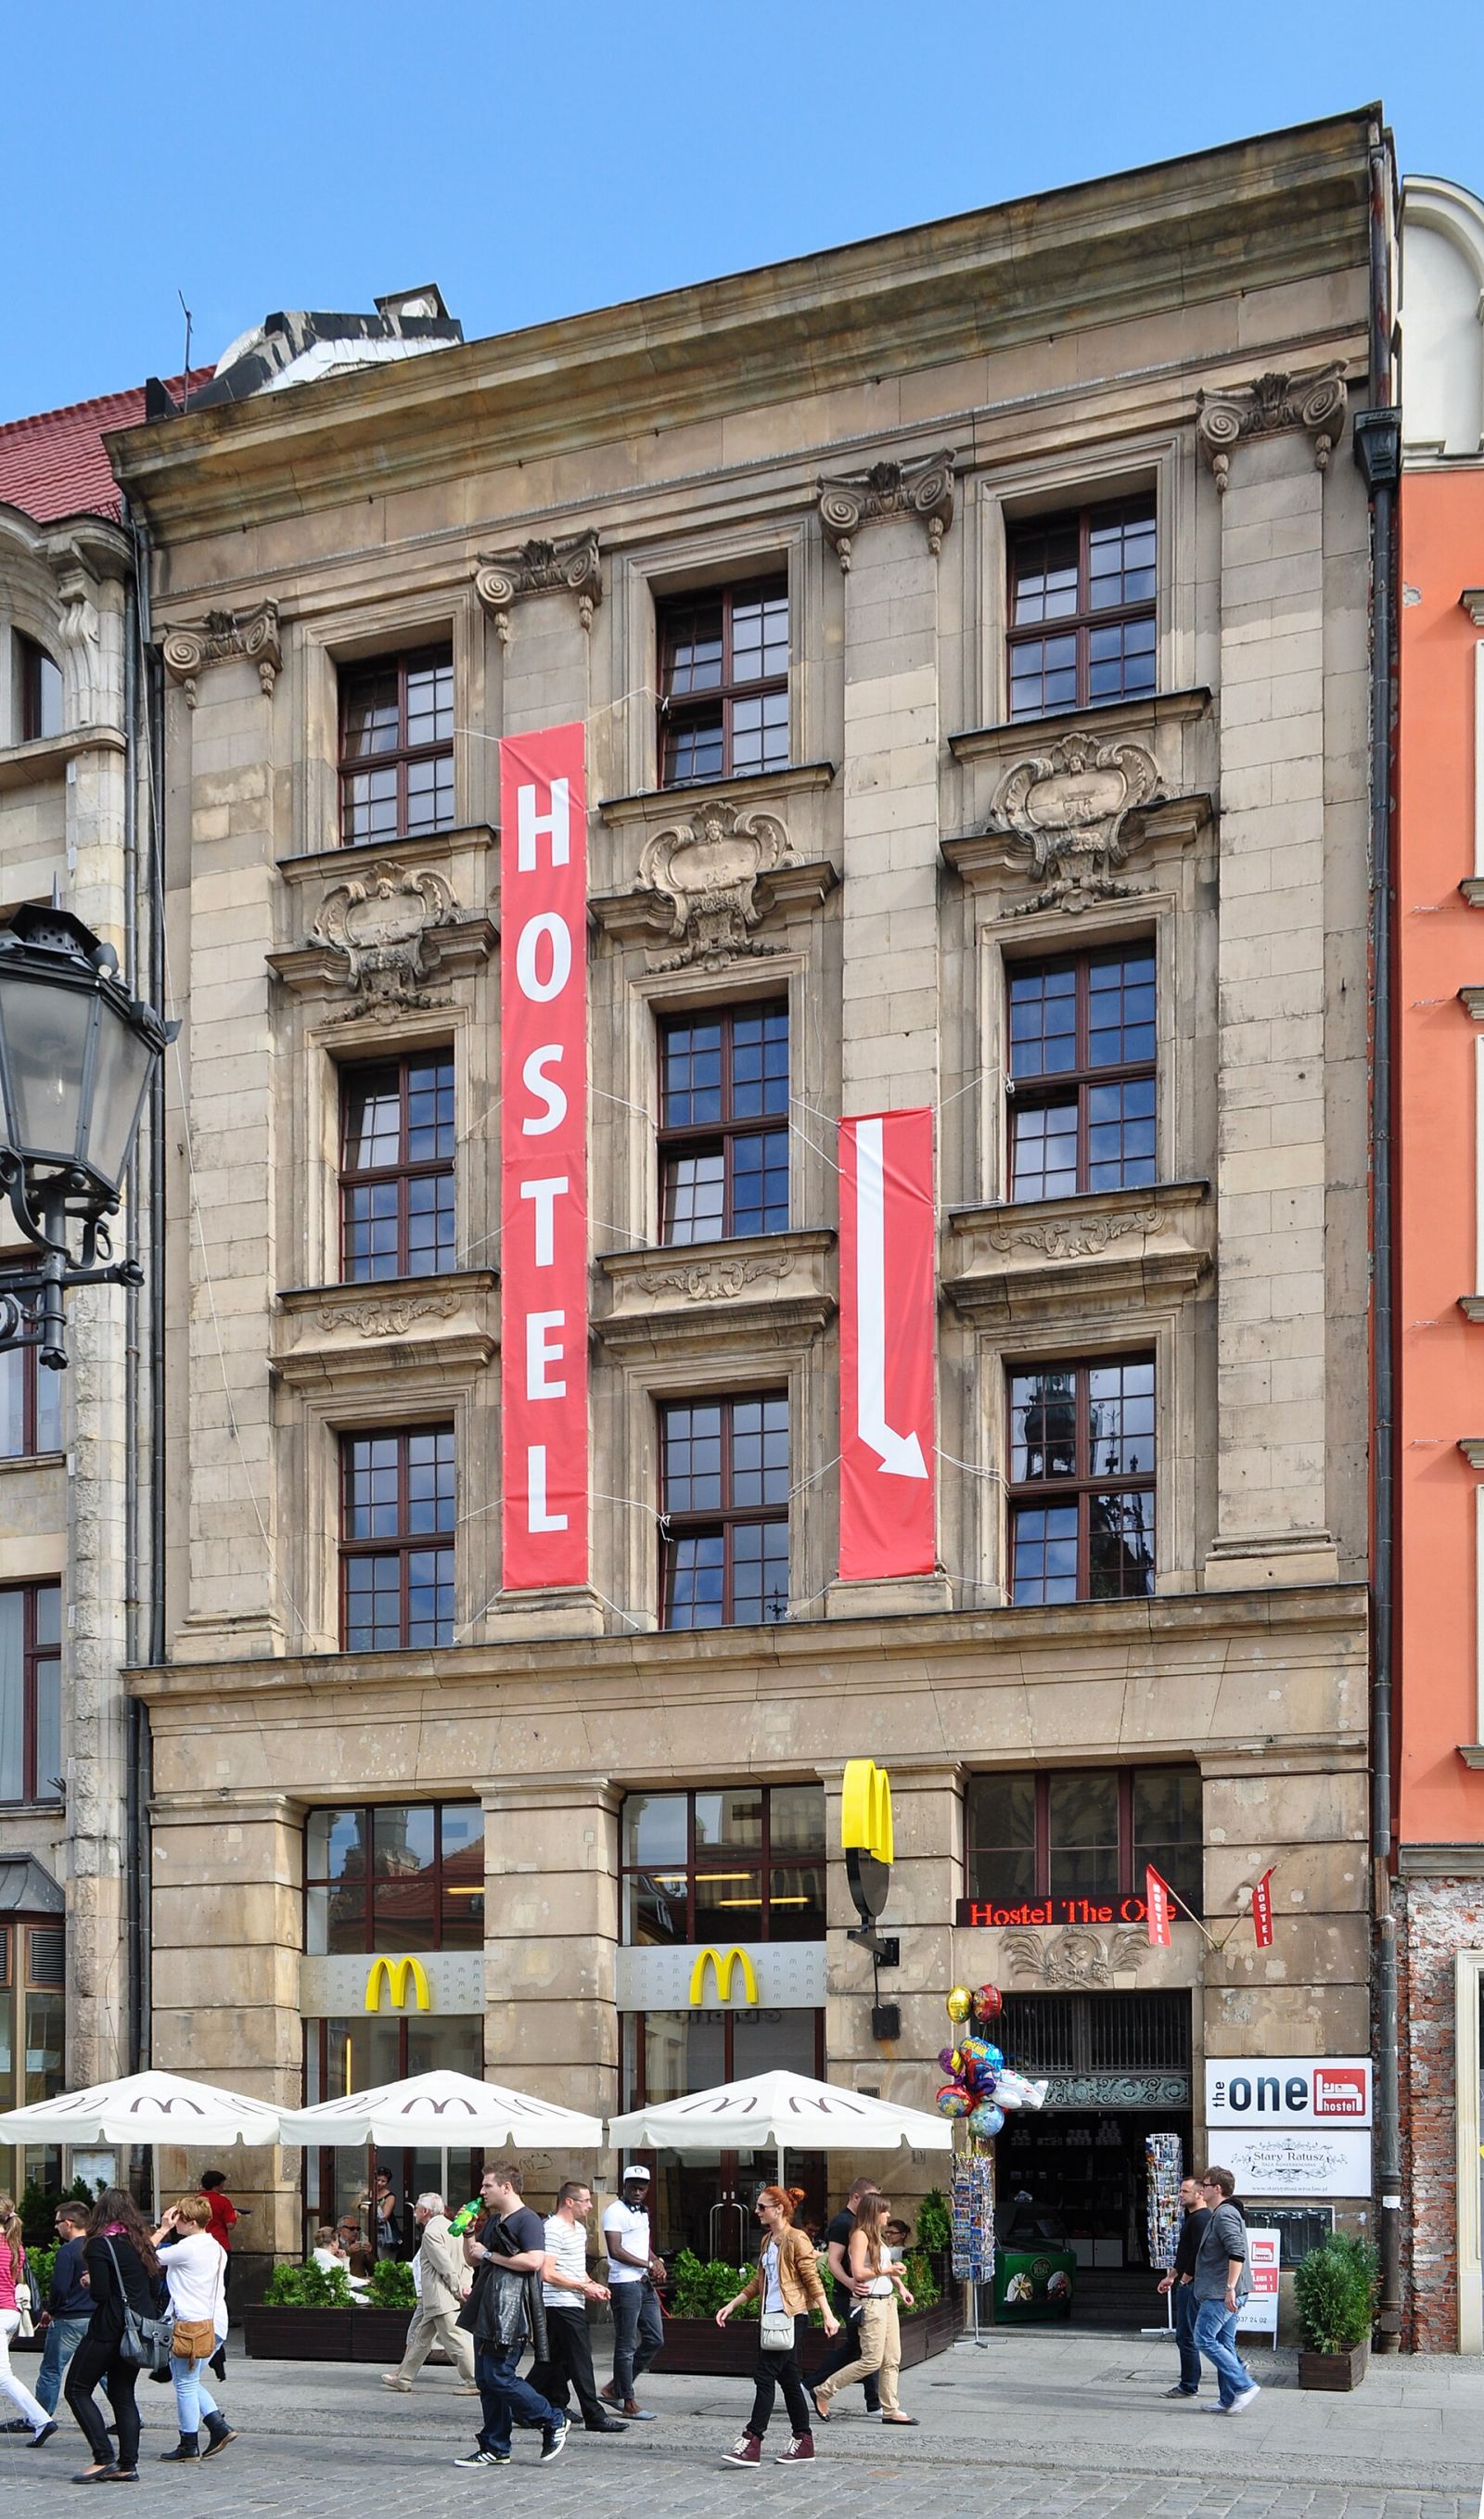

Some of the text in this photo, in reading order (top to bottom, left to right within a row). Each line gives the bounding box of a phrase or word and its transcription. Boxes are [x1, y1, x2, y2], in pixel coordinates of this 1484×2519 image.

[516, 777, 571, 1533] HOSTEL
[970, 1899, 1177, 1926] Hostel The Oe
[1153, 1884, 1164, 1944] HOSTEL
[1257, 1884, 1270, 1945] HOSTEL
[1212, 2077, 1309, 2112] the one
[1324, 2100, 1356, 2112] hostel
[1254, 2152, 1325, 2163] Stary Ratusz
